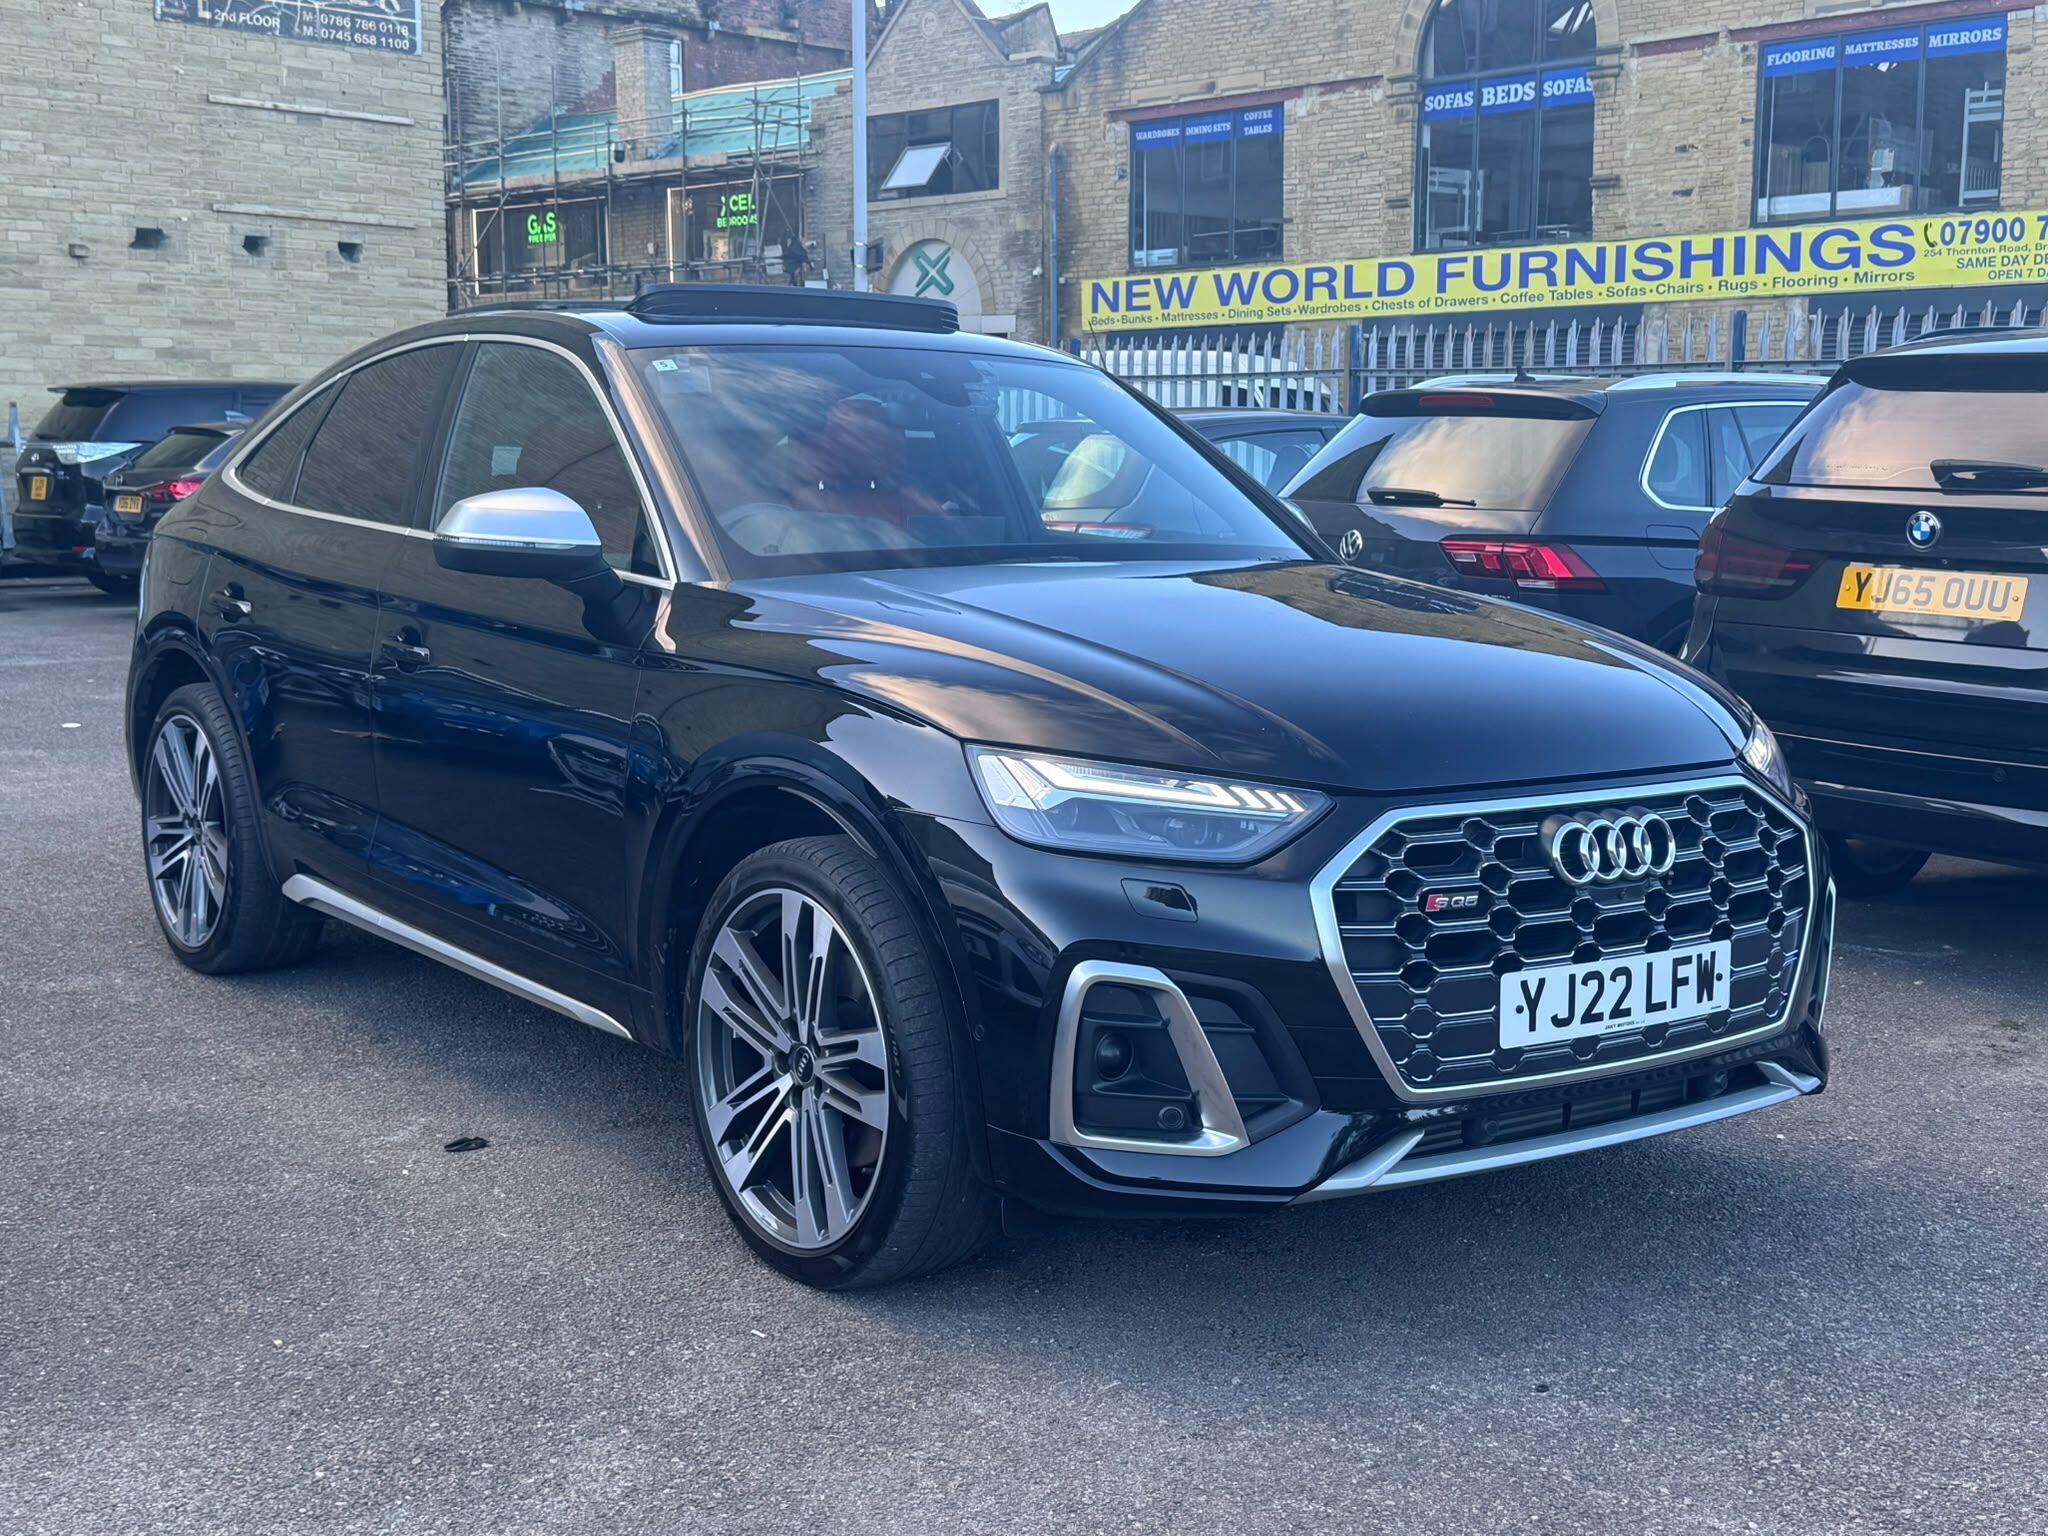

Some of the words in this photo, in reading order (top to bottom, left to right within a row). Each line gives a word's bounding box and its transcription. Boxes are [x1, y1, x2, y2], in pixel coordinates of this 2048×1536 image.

[240, 13, 280, 28] FLOOR
[321, 14, 351, 29] 0786
[355, 18, 376, 31] 786
[321, 28, 351, 42] 0745
[354, 33, 377, 45] 658
[380, 37, 409, 50] 1100
[1767, 46, 1836, 67] FLOORING
[1845, 36, 1919, 56] MATTRESSES
[1928, 27, 2002, 49] MIRRORS
[1424, 90, 1474, 112] SOFAS
[1481, 81, 1536, 107] BEDS
[1543, 76, 1593, 98] SOFAS
[1244, 109, 1273, 121] COFFEE
[1135, 128, 1180, 141] WARDROBES
[1185, 124, 1212, 136] DINING
[1213, 122, 1232, 133] SETS
[1244, 123, 1273, 136] TABLES
[1940, 217, 2026, 246] 07900
[1924, 249, 1942, 257] 254
[1946, 246, 1995, 256] Thornton
[2000, 243, 2031, 254] Road,
[1091, 275, 1199, 314] NEW
[1212, 261, 1415, 307] WORLD
[1436, 224, 1916, 294] FURNISHINGS
[1956, 256, 1997, 269] SAME
[2001, 254, 2030, 267] DAY
[1988, 269, 2023, 280] OPEN
[2027, 268, 2034, 278] 7
[2037, 268, 2048, 278] D
[1091, 316, 1115, 326] Beds
[1121, 314, 1153, 325] Bunks
[1161, 310, 1218, 322] Mattresses
[1228, 306, 1263, 320] Dining
[1267, 305, 1291, 317] Sets
[1297, 302, 1361, 315] Wardrobes
[1372, 298, 1414, 311] Chests
[1418, 297, 1431, 308] of
[1434, 294, 1489, 308] Drawers
[1500, 291, 1545, 304] Coffee
[1549, 288, 1593, 301] Tables
[1605, 285, 1647, 298] Sofas
[1655, 282, 1704, 296] Chairs
[1718, 279, 1758, 293] Rugs
[1772, 274, 1838, 289] Flooring
[1853, 270, 1915, 285] Mirrors
[1855, 571, 1936, 607] YJ65
[1942, 577, 2013, 613] OUU
[1520, 965, 1633, 1033] YJ22
[1645, 950, 1717, 1015] LFW
